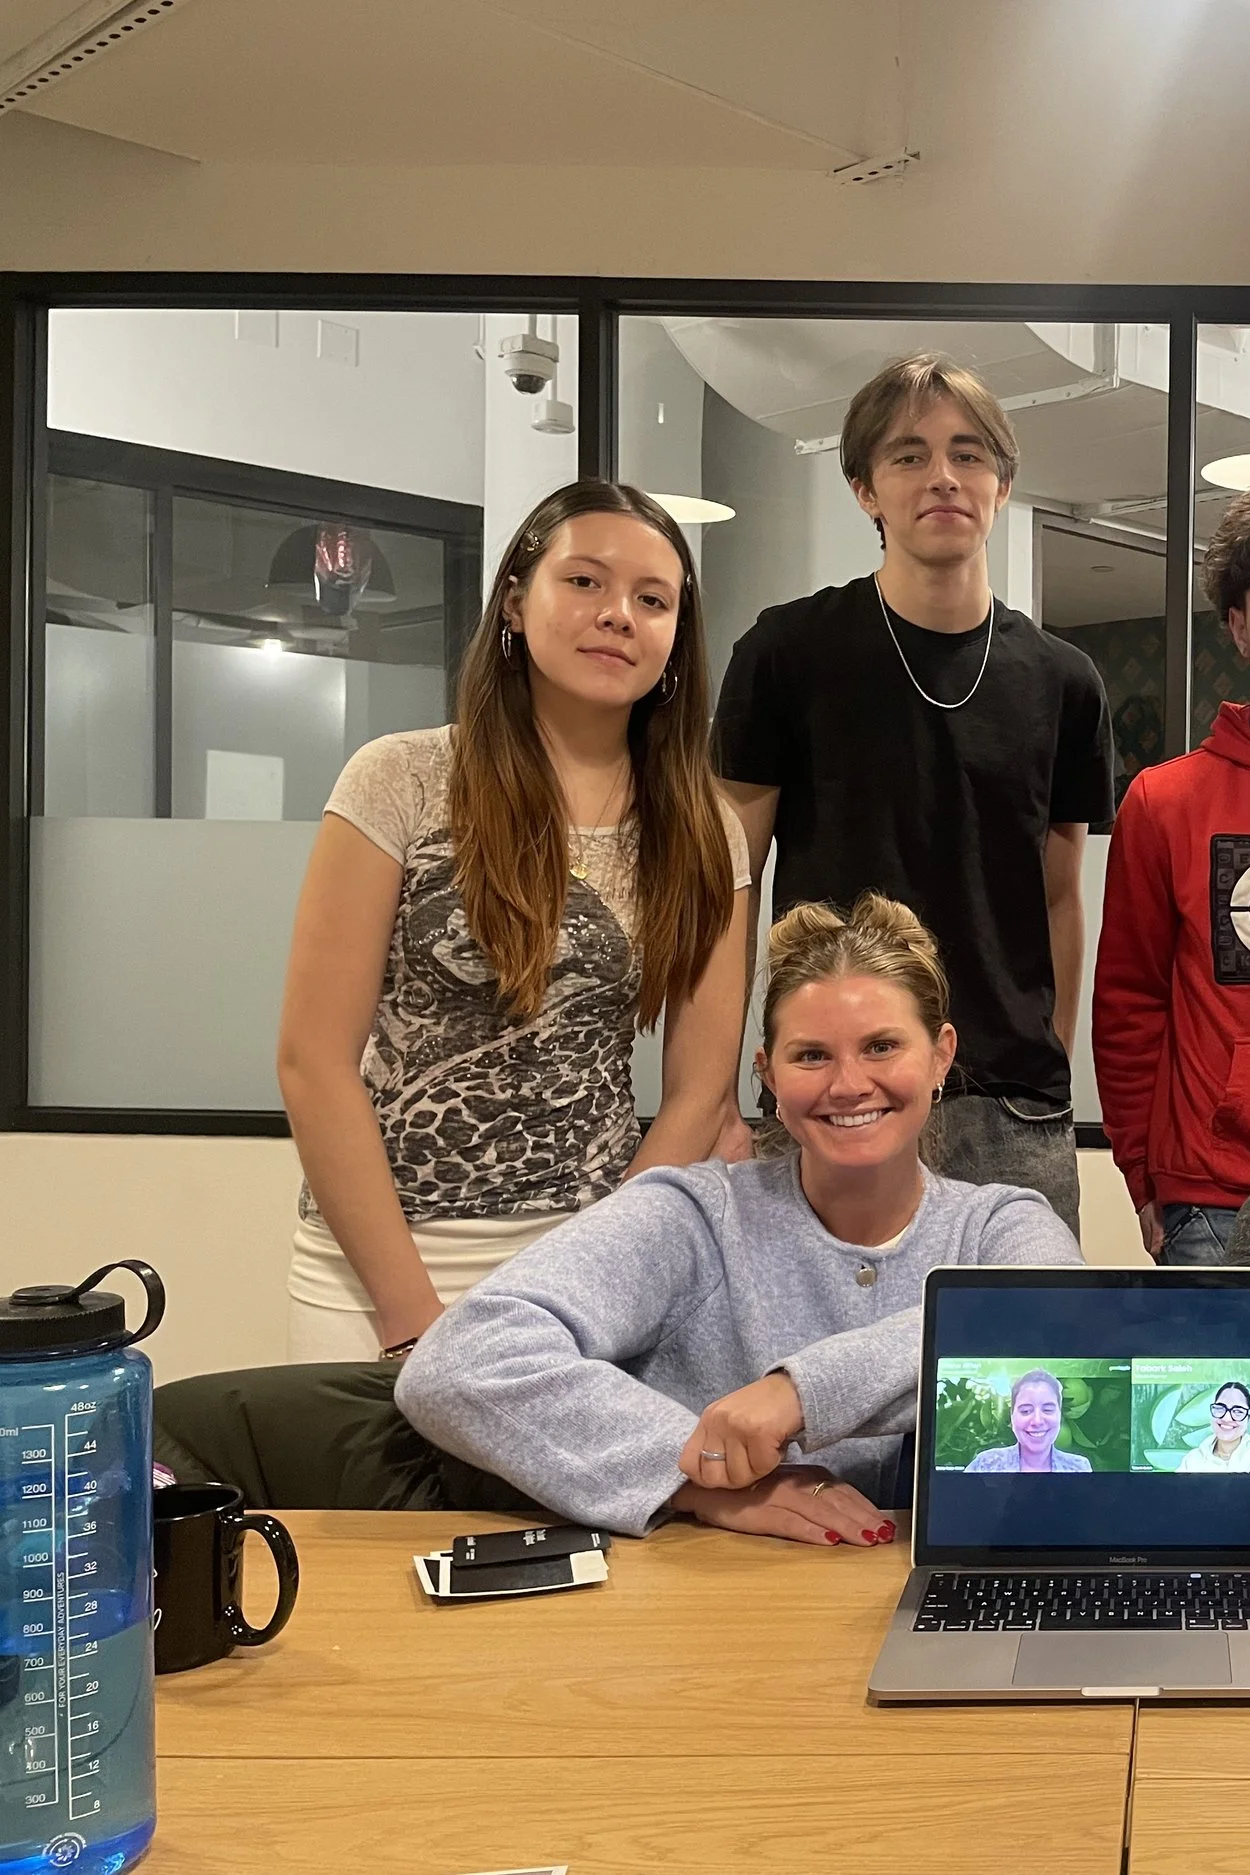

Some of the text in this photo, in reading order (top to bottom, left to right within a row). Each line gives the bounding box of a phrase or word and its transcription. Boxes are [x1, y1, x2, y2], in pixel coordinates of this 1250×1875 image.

[70, 1401, 97, 1412] 48oz
[83, 1439, 97, 1450] 44
[21, 1448, 47, 1459] 1300
[21, 1483, 47, 1494] 1200
[83, 1480, 97, 1490] 40
[22, 1518, 47, 1529] 1100
[83, 1521, 97, 1531] 36
[23, 1552, 49, 1563] 1000
[84, 1561, 97, 1572] 32
[23, 1588, 43, 1599] 900
[57, 1571, 65, 1624] ADVENTURES
[84, 1600, 98, 1612] 28
[23, 1623, 44, 1634] 800
[85, 1640, 98, 1652] 24
[24, 1657, 44, 1668] 700
[58, 1668, 66, 1690] YOUR
[86, 1681, 99, 1692] 20
[24, 1691, 45, 1702] 600
[58, 1691, 66, 1708] FOR
[25, 1725, 45, 1736] 500
[87, 1720, 99, 1731] 16
[88, 1759, 100, 1770] 12
[25, 1793, 46, 1804] 300
[94, 1799, 100, 1809] 8
